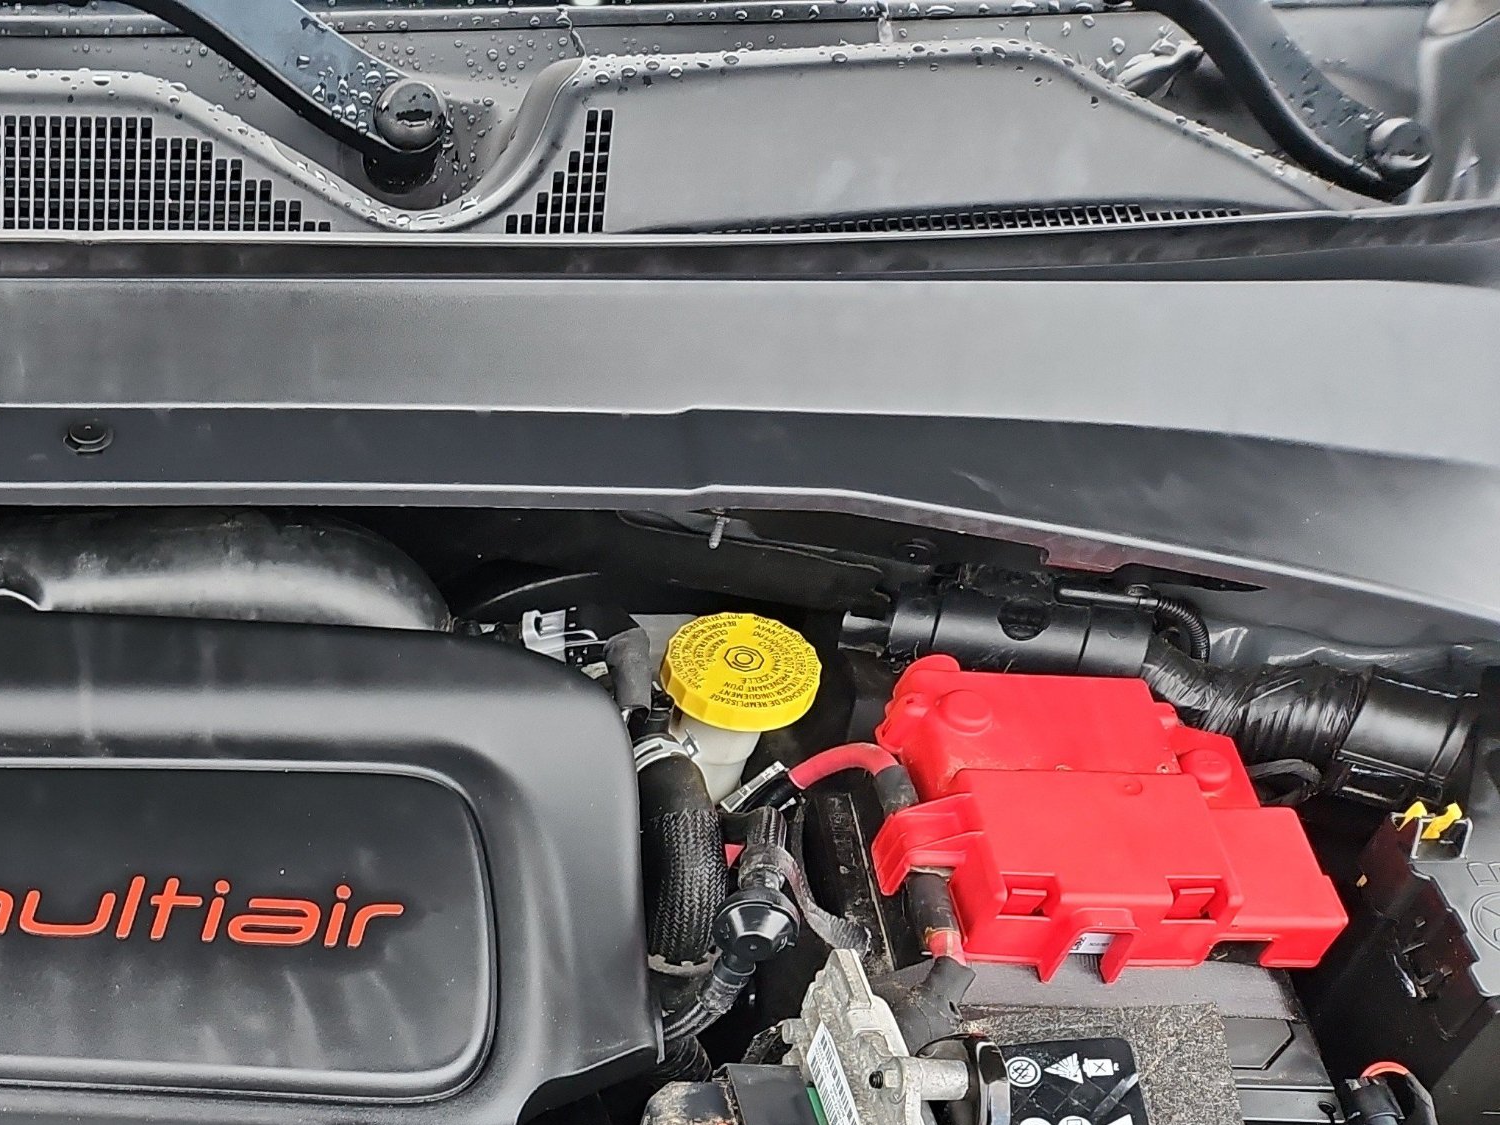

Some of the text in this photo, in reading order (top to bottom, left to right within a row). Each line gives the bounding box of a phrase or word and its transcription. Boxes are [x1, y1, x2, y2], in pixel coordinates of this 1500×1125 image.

[757, 640, 783, 675] CONTENANT
[747, 672, 791, 691] PROVENANT
[708, 692, 768, 707] REMPLISSAGE
[718, 688, 776, 699] UNIQUEMENT
